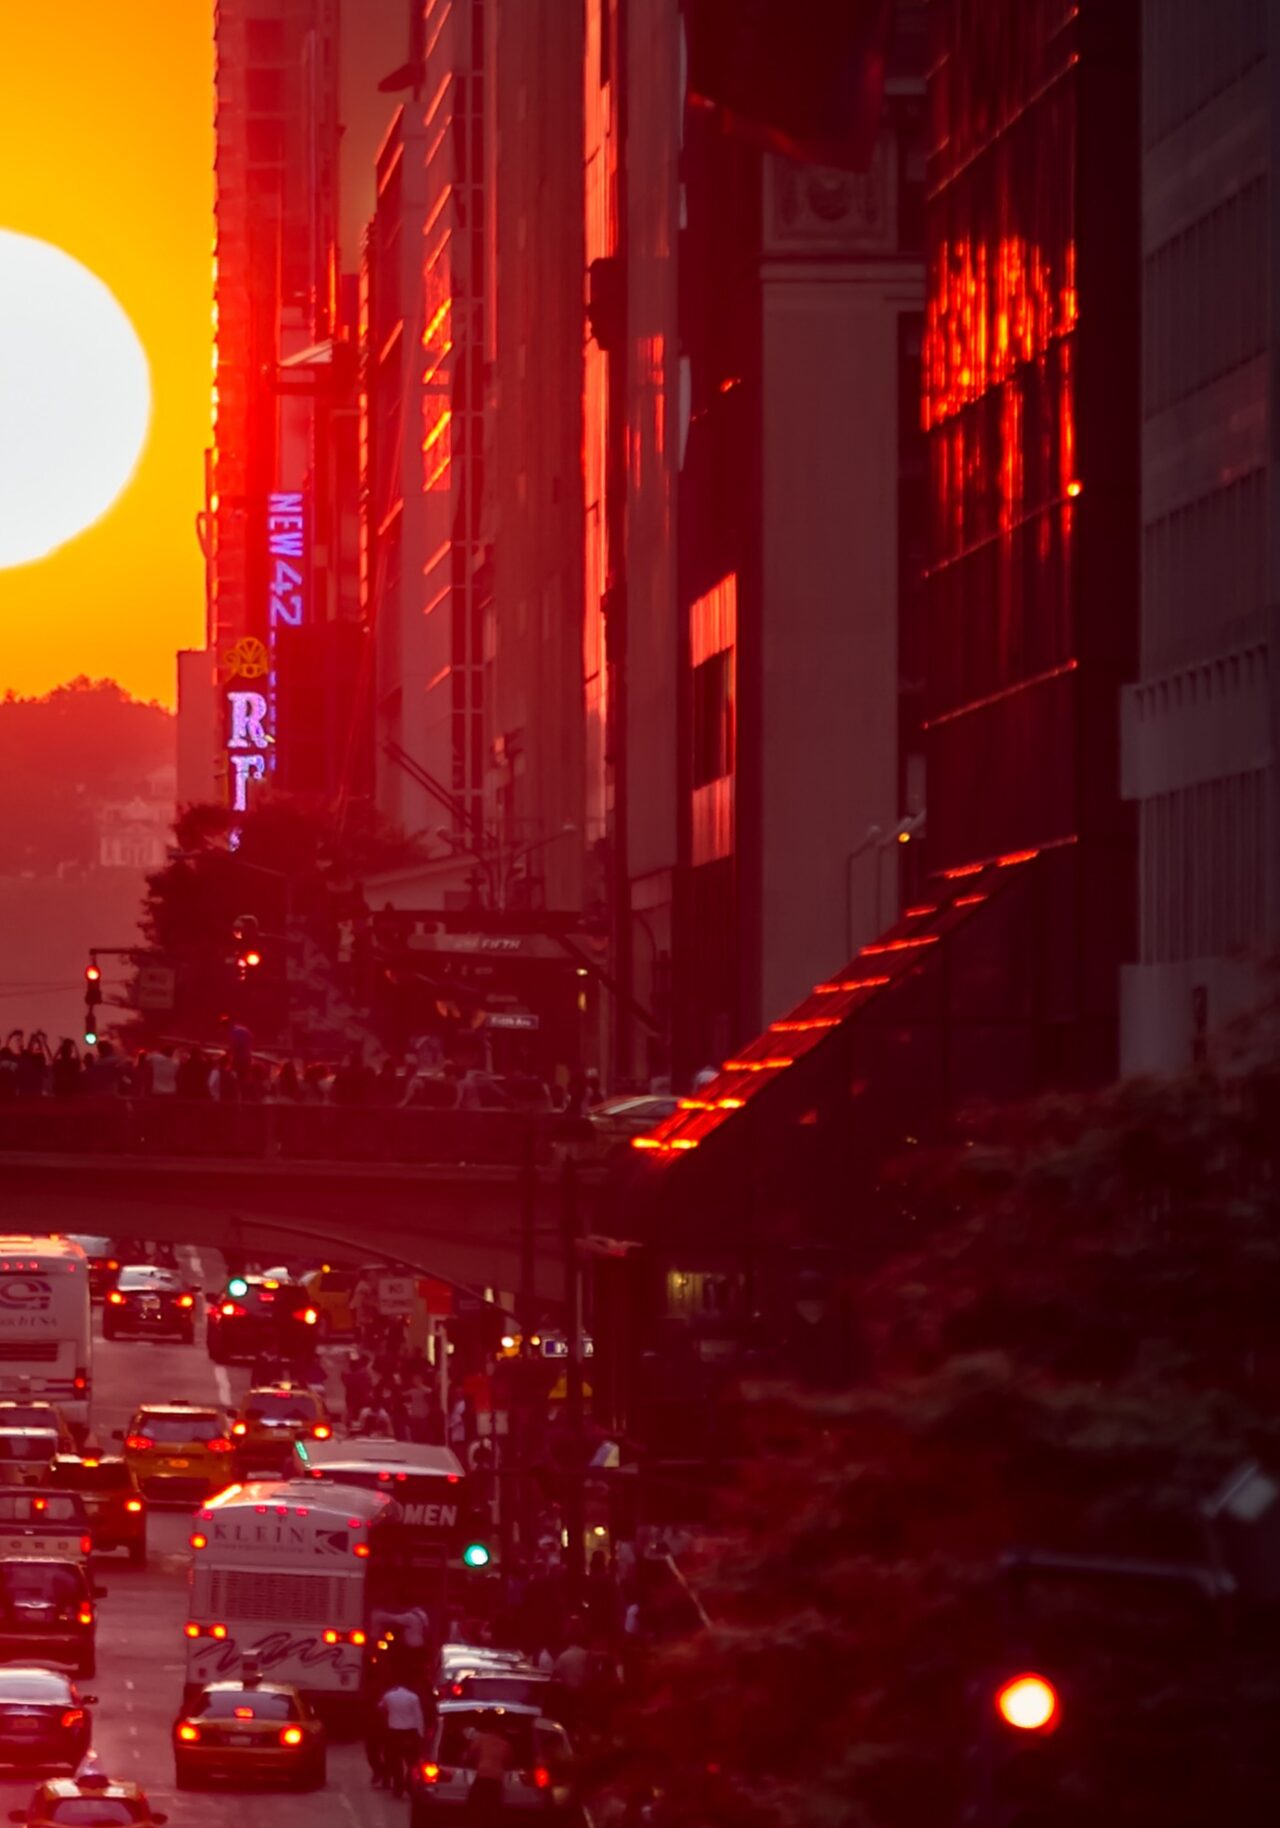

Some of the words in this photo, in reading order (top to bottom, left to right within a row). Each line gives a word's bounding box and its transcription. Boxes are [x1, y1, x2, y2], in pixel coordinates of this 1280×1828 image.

[268, 492, 303, 556] NEW
[270, 560, 303, 627] 42
[213, 1523, 305, 1544] KLEIN
